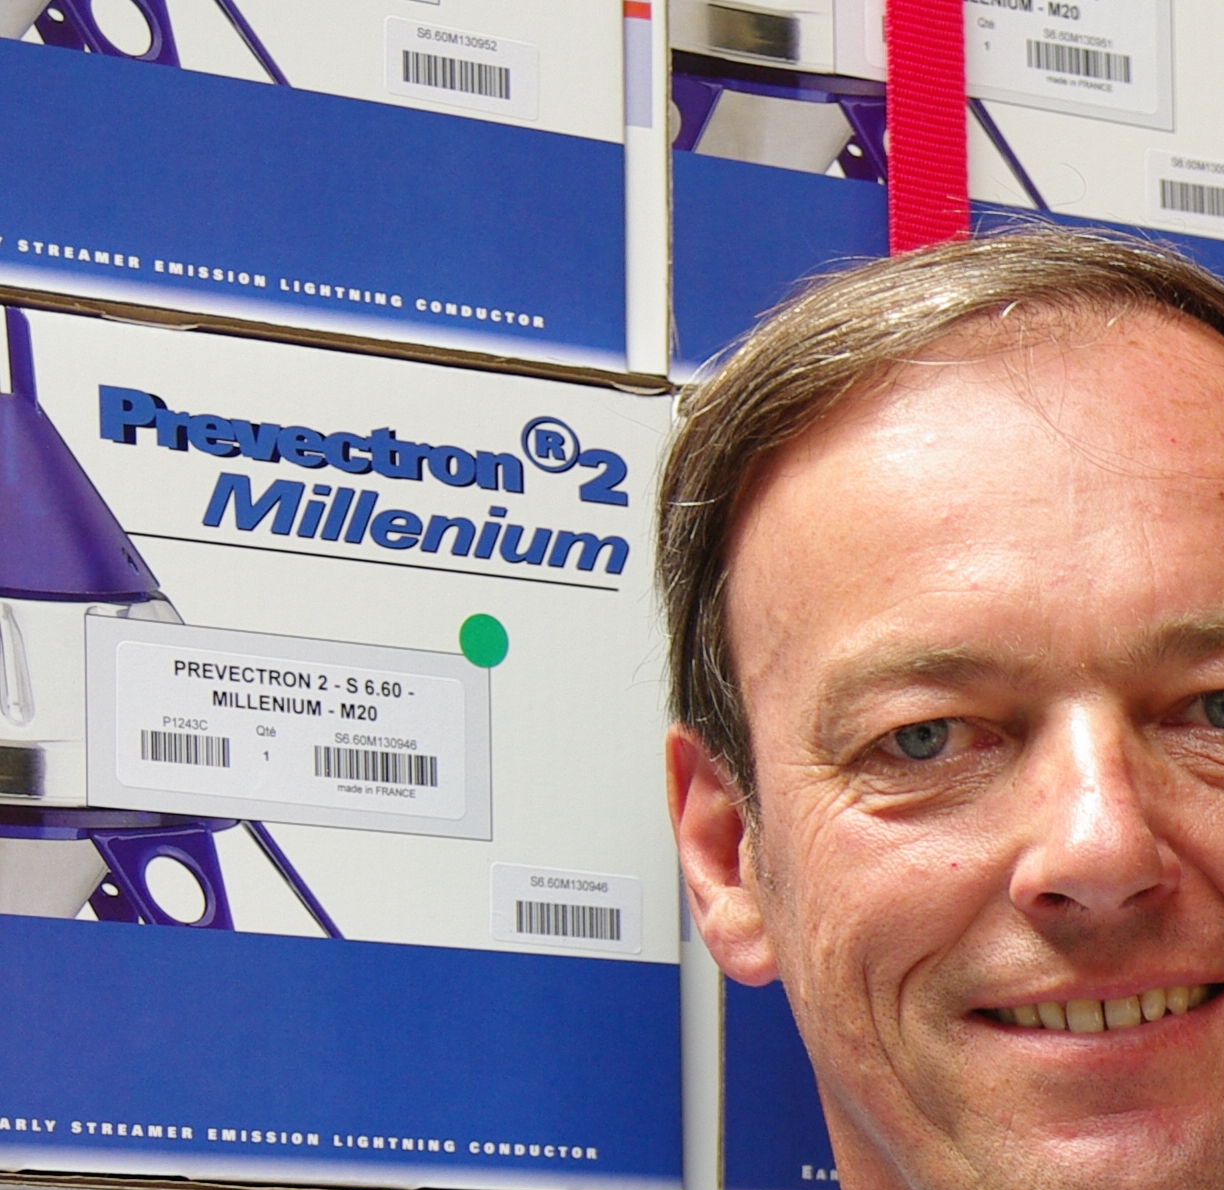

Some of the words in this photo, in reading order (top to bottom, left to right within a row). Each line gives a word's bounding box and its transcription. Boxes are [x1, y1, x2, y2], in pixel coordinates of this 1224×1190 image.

[1048, 1, 1081, 20] M20
[417, 27, 498, 52] S6.60M130952
[18, 239, 140, 269] STREAMER
[154, 260, 266, 288] EMISSION
[280, 278, 403, 308] LIGHTNING
[415, 298, 545, 329] CONDUCTOR
[202, 472, 630, 575] Millenium
[174, 660, 311, 689] PREVECTRON
[318, 675, 328, 690] 2
[346, 678, 358, 694] S
[365, 680, 402, 698] 6.60
[212, 690, 322, 716] MILLENIUM
[340, 703, 378, 721] M20
[162, 716, 208, 731] P1243C
[256, 725, 276, 738] Qté
[334, 733, 417, 750] S6.60M130946
[263, 751, 270, 761] 1
[337, 783, 362, 795] made
[365, 785, 373, 795] in
[376, 786, 416, 799] FRANCE
[71, 1121, 193, 1139] STREAMER
[208, 1128, 319, 1146] EMISSION
[333, 1134, 455, 1153] LIGHTNING
[469, 1141, 598, 1160] CONDUCTOR
